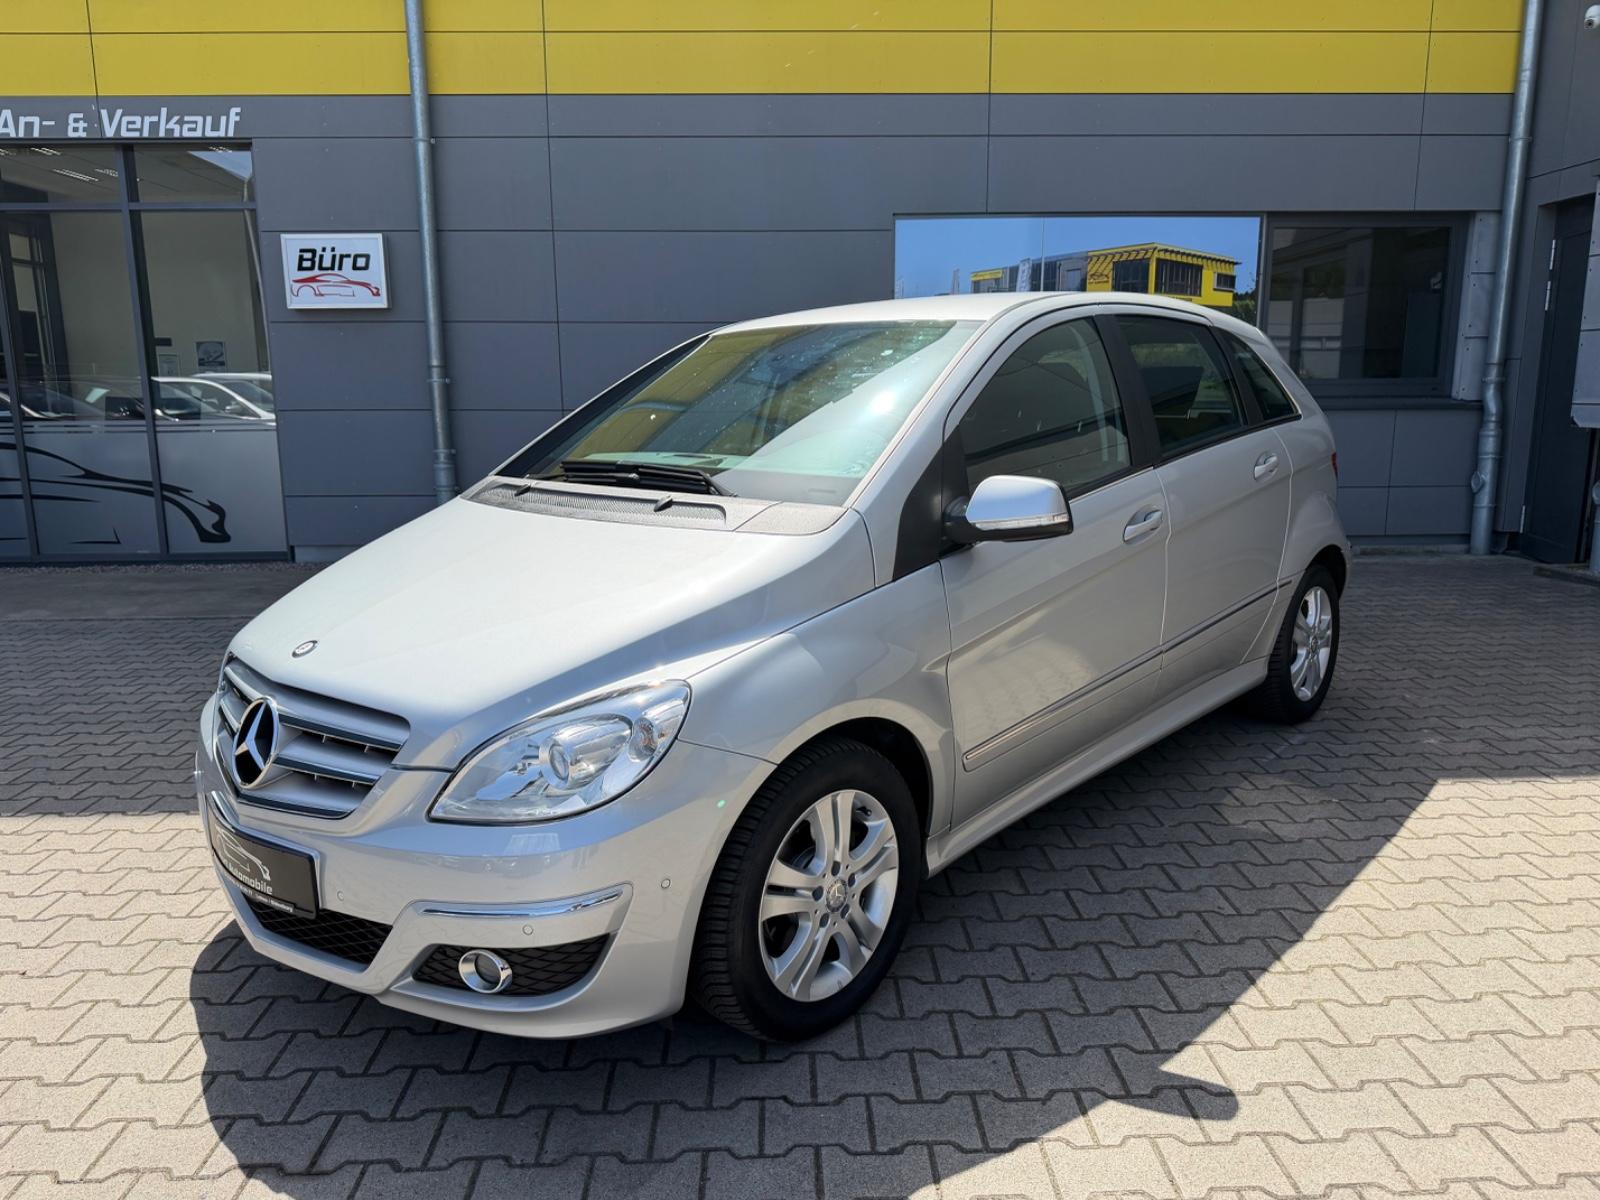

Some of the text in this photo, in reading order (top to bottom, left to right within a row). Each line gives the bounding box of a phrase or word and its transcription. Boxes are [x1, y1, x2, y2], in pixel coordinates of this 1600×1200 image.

[0, 107, 242, 138] An- & Verkauf
[296, 246, 371, 272] Büro
